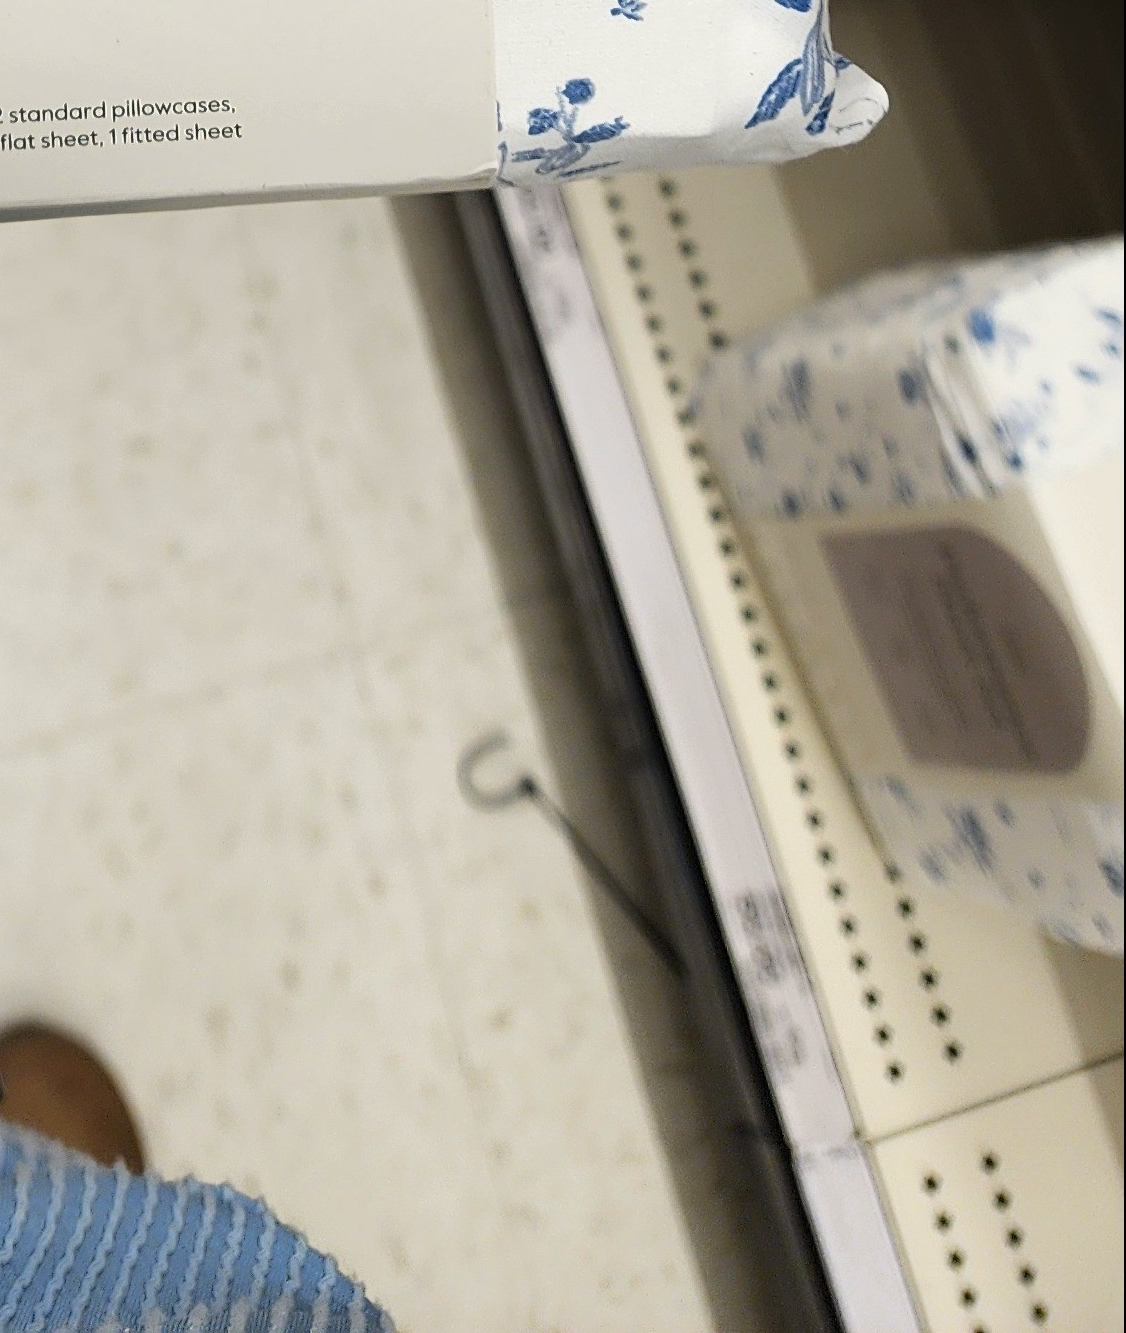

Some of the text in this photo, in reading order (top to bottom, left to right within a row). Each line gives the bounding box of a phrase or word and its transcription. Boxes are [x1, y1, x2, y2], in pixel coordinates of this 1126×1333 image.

[8, 100, 106, 124] standard
[111, 98, 236, 122] pillowcases,
[0, 132, 36, 152] flat
[40, 130, 104, 149] sheet,
[108, 127, 116, 146] 1
[121, 123, 179, 145] fitted
[184, 122, 243, 141] sheet
